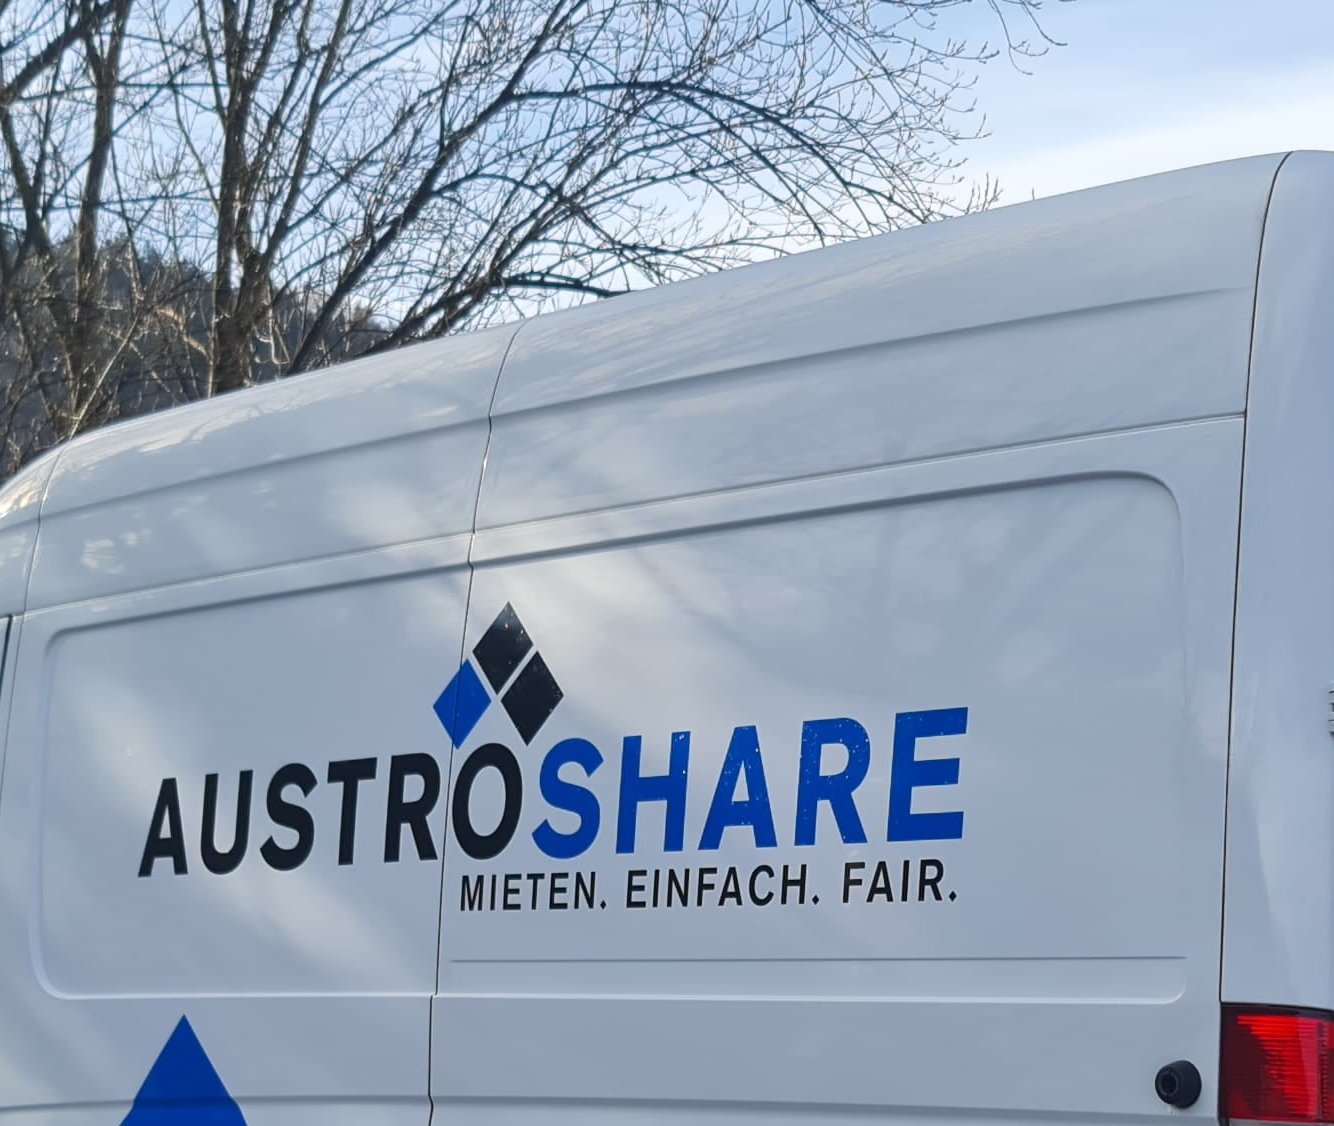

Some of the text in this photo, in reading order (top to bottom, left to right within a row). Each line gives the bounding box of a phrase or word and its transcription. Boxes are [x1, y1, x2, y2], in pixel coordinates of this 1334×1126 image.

[138, 706, 969, 878] AUSTROSHARE
[460, 858, 958, 911] MIETEN. EINFACH. FAIR.
